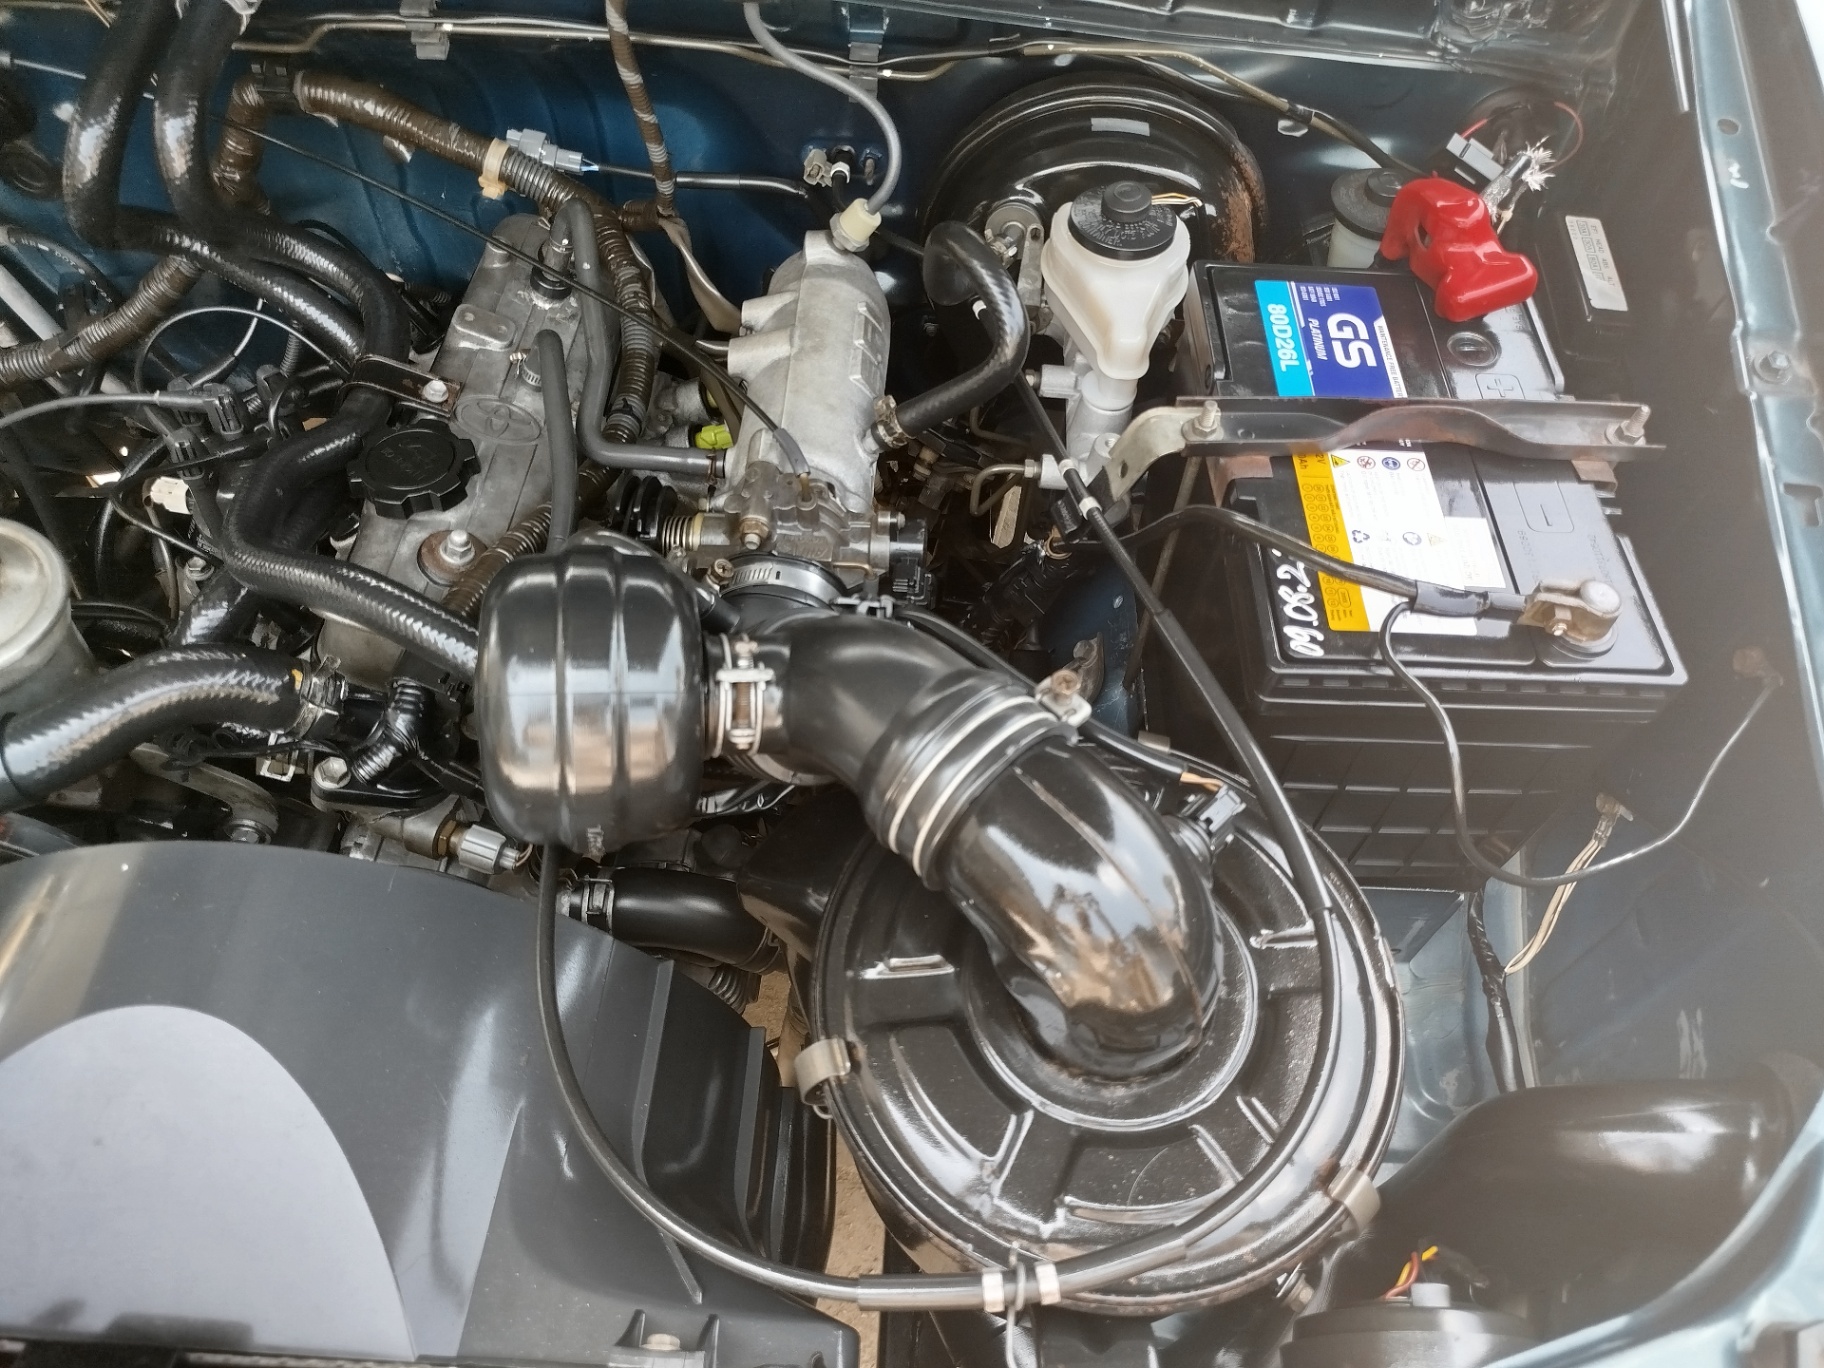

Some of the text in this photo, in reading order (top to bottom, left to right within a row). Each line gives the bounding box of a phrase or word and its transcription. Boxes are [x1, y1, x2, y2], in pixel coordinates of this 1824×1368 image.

[1267, 303, 1300, 372] 80D26L
[1308, 317, 1328, 361] PLATINUM
[1327, 312, 1377, 369] GS
[1378, 325, 1404, 398] MAINTENANCE FREE BATTER
[1298, 454, 1308, 470] 0Ah
[1271, 548, 1324, 656] 09.08.2
